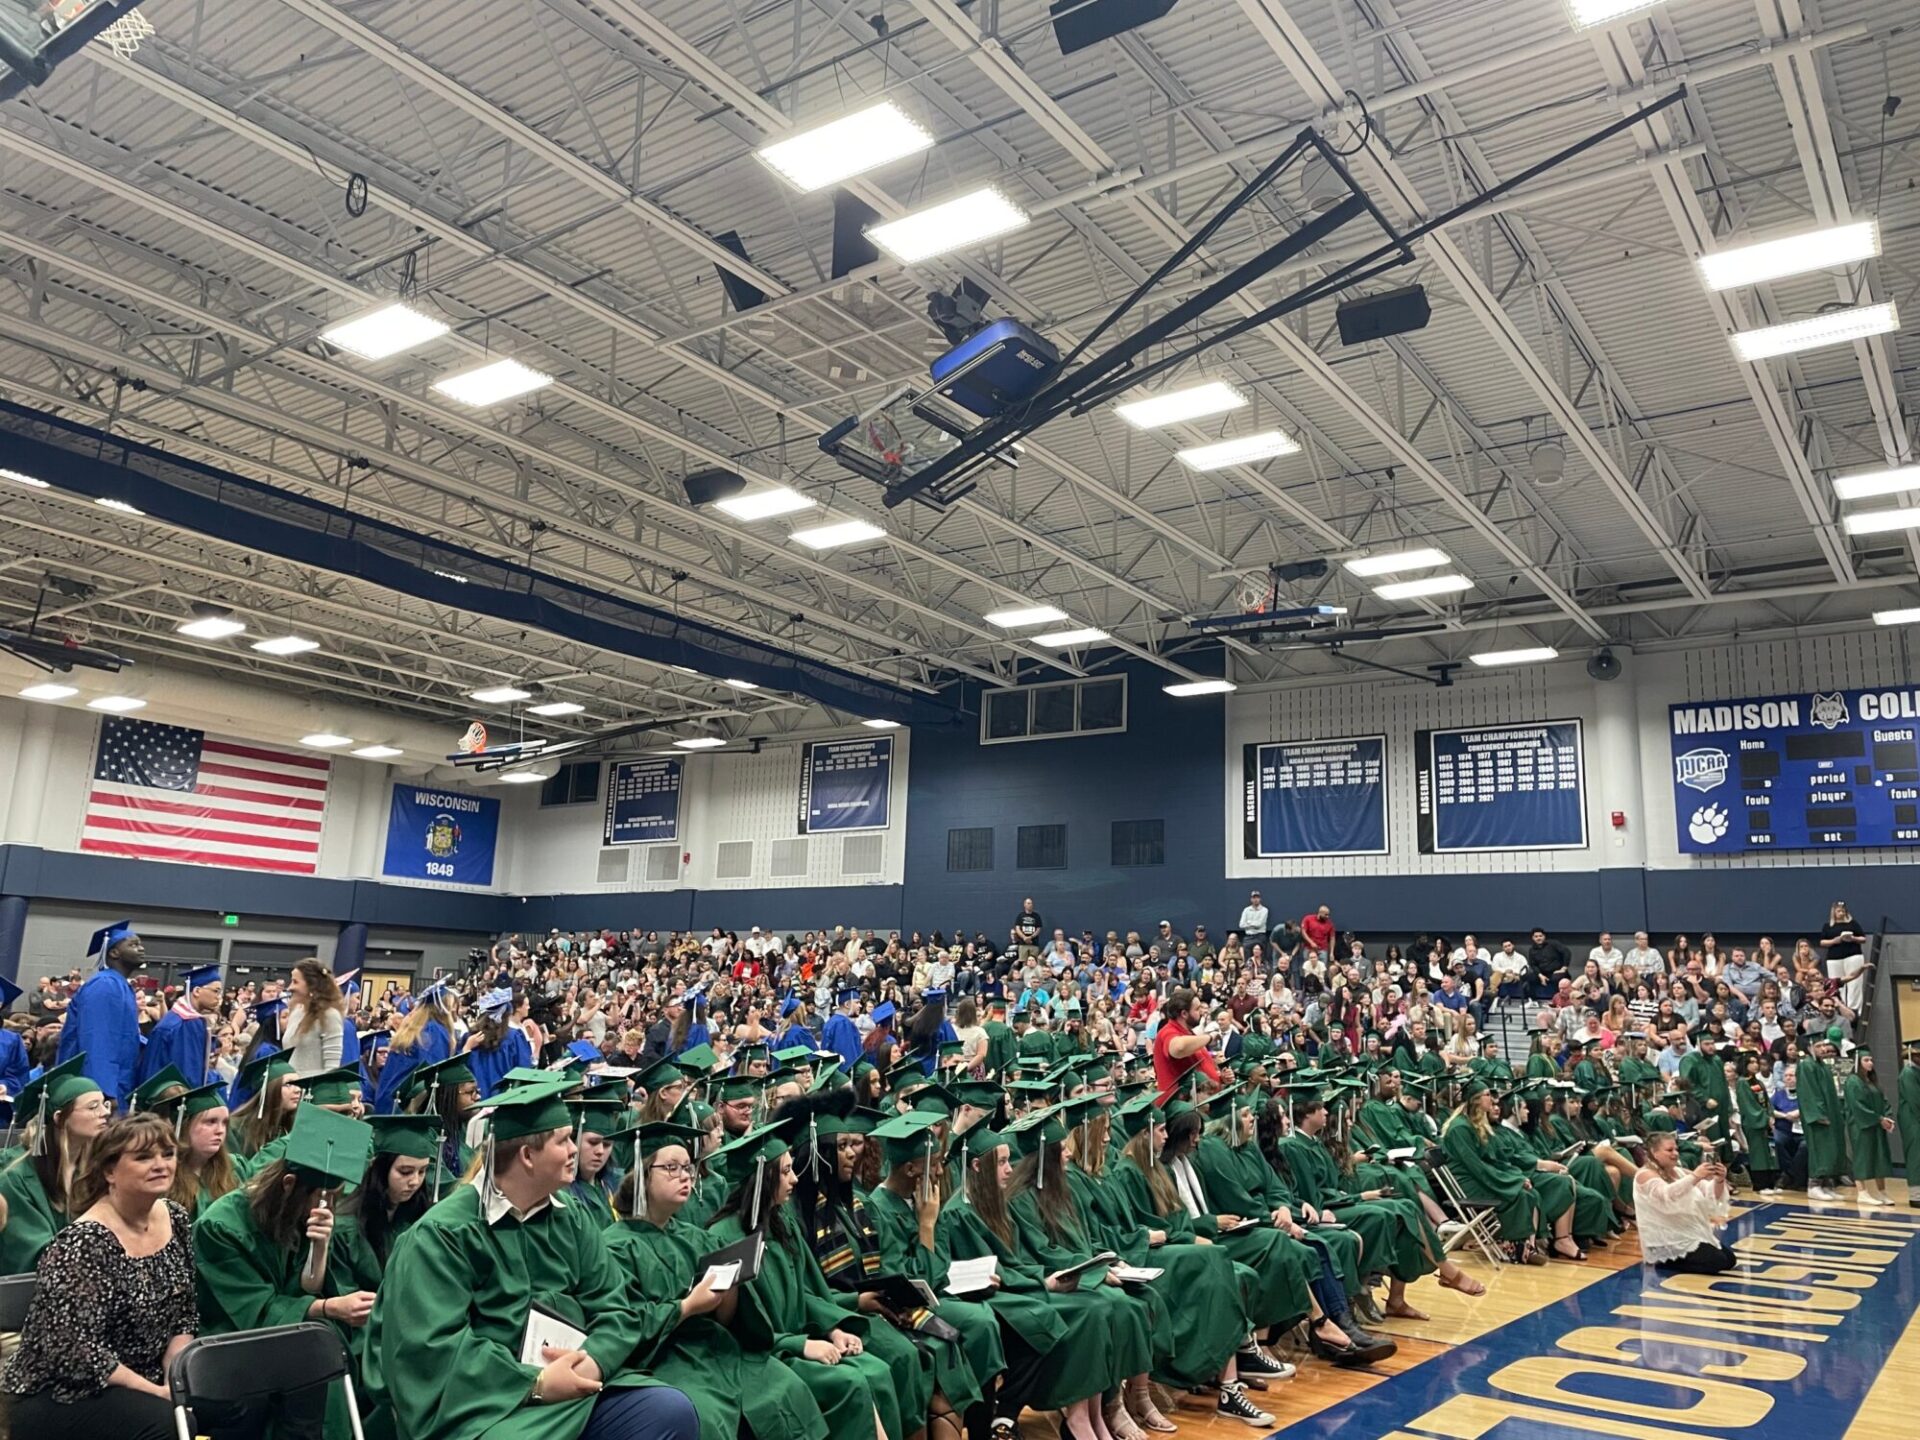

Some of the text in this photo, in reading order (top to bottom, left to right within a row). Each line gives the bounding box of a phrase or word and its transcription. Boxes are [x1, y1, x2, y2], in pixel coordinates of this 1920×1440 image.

[1673, 701, 1799, 735] MADISON
[1461, 728, 1549, 743] TEAM CHAMPIONSHIPS
[1874, 729, 1913, 742] Guests
[1283, 744, 1358, 756] TEAM CHAMPIONSHIPS
[1468, 740, 1542, 752] CONFERENCE CHAMPIONS
[1740, 739, 1765, 750] Home
[1678, 756, 1725, 779] NJCAA
[802, 757, 810, 798] BASKETBALL
[1811, 774, 1845, 786] period
[1420, 769, 1429, 815] BASEBALL
[1812, 791, 1846, 803] player
[1891, 788, 1917, 799] fouls
[415, 791, 480, 813] WISCONSIN
[1746, 795, 1770, 805] fouls
[1751, 835, 1770, 843] won
[1824, 832, 1842, 841] set
[1897, 830, 1918, 838] won
[426, 862, 454, 877] 1848
[1610, 1212, 1920, 1342] MADISON
